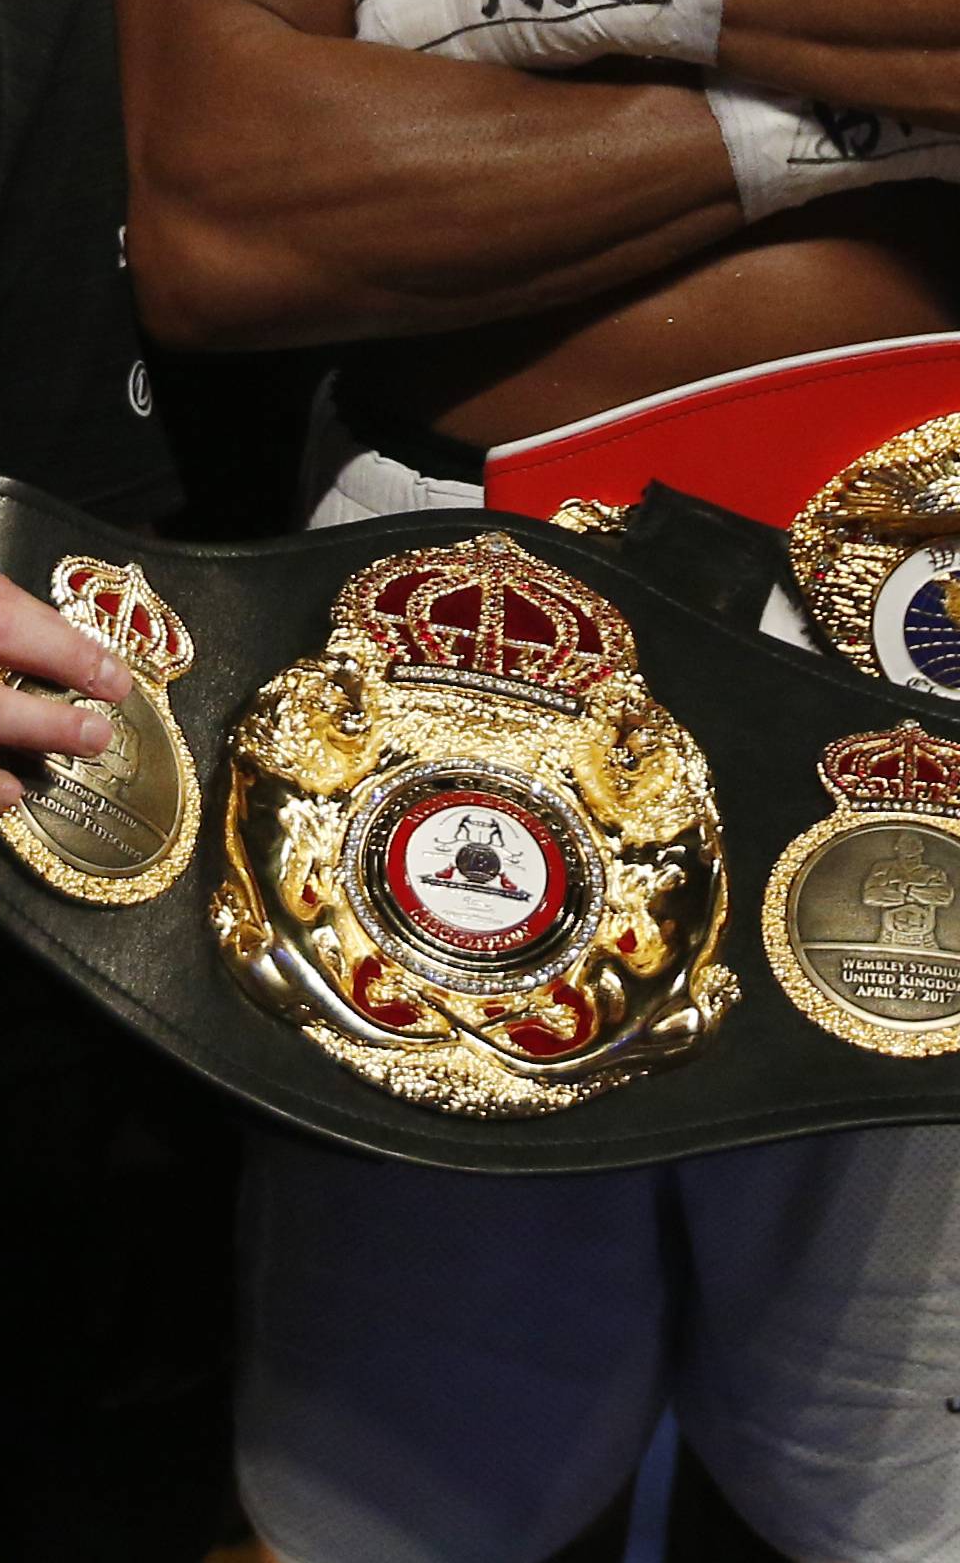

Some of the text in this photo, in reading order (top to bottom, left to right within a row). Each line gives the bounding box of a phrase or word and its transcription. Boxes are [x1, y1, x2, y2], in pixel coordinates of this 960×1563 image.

[51, 772, 99, 804] NTHONY
[842, 958, 960, 978] WEMBLEY STADIU
[843, 970, 896, 985] UNITED
[856, 985, 897, 999] APRIL
[921, 989, 954, 1004] 2017
